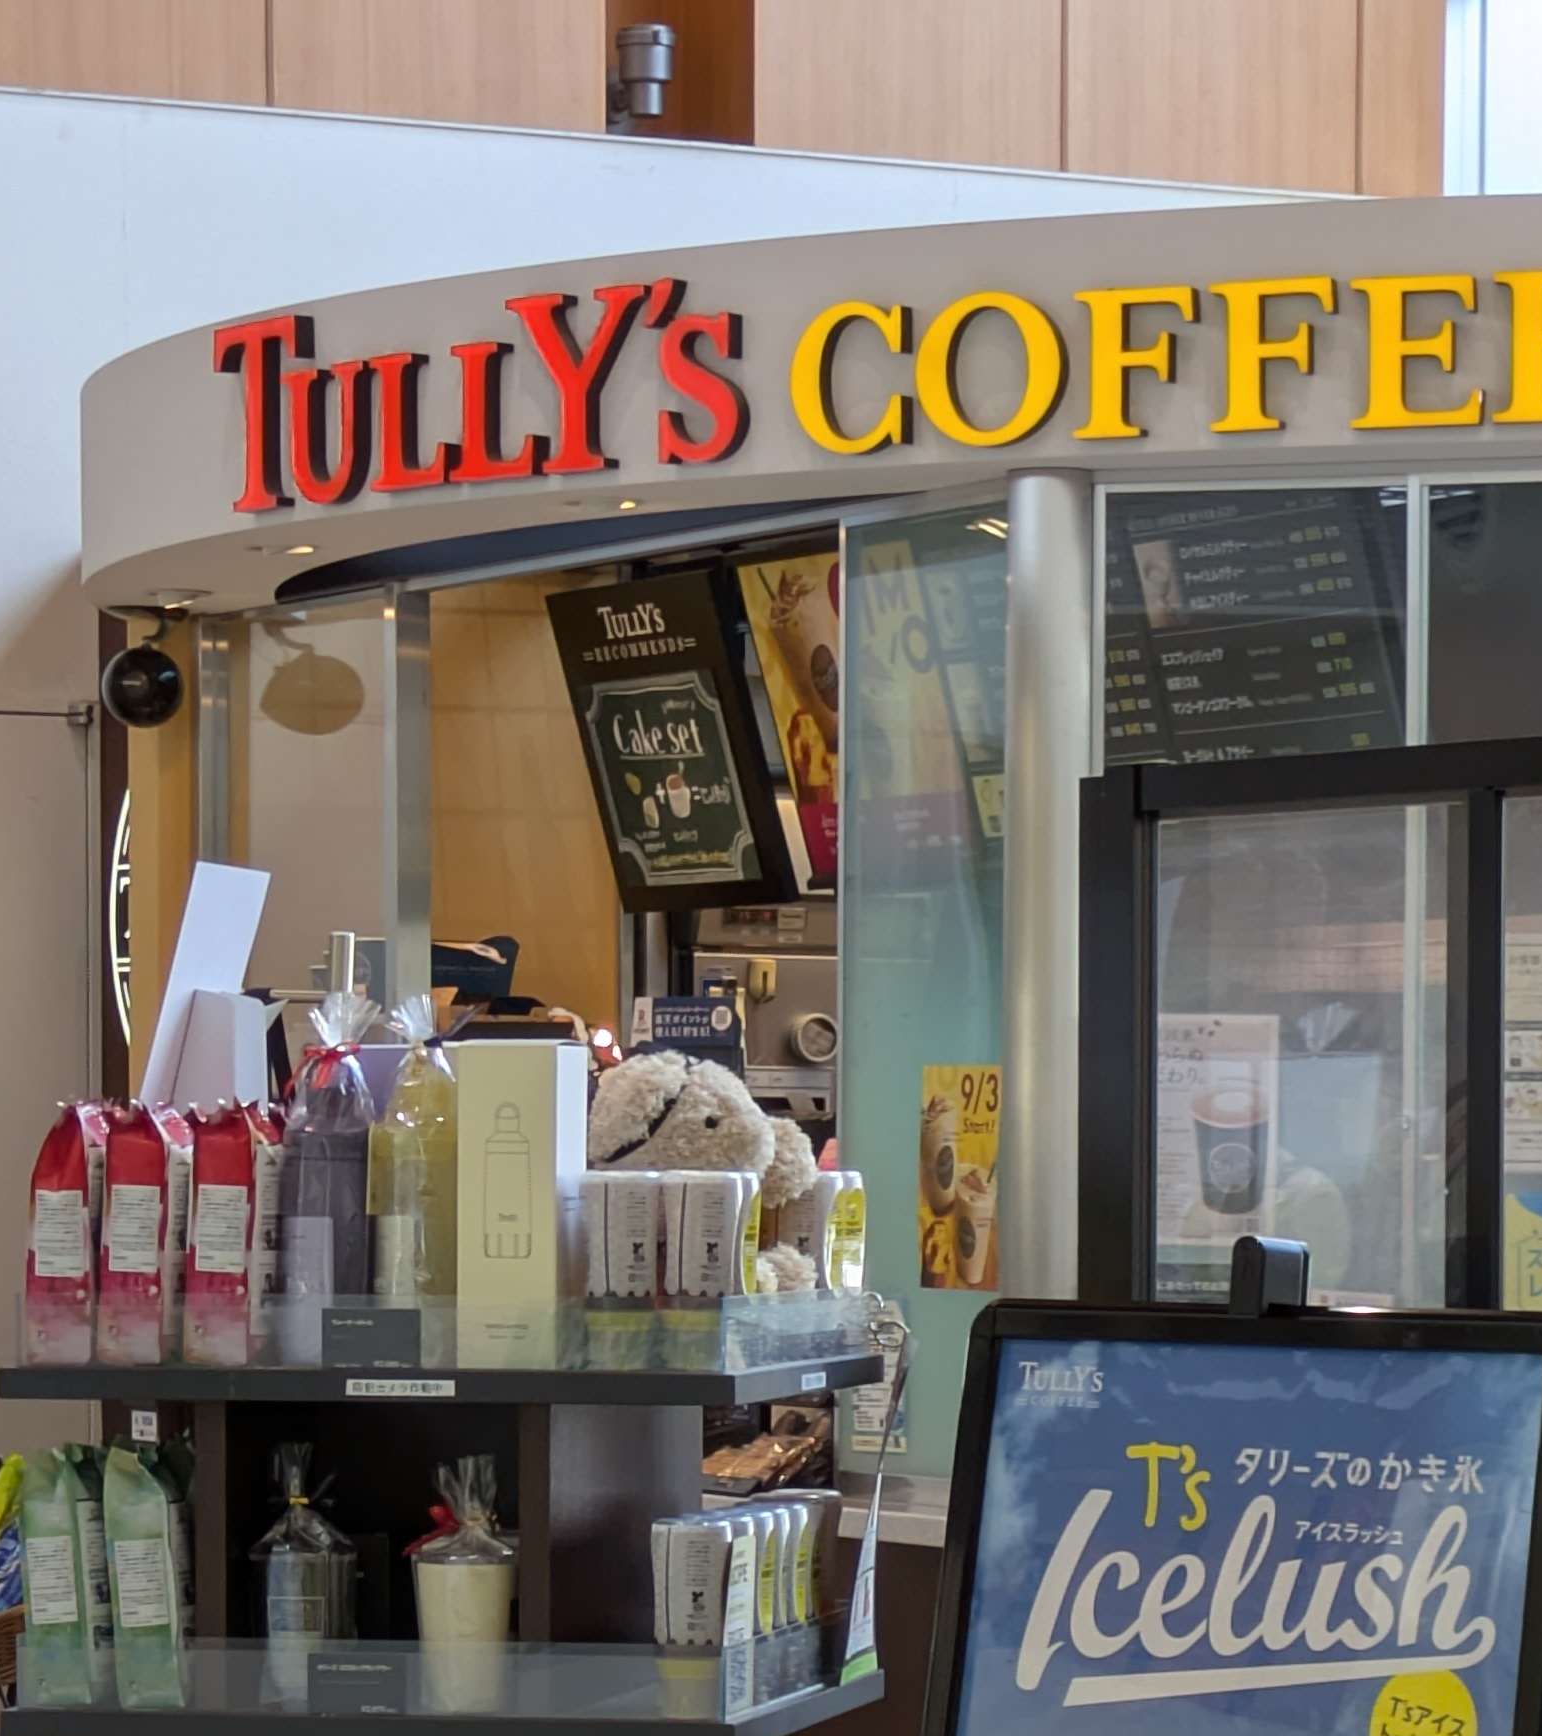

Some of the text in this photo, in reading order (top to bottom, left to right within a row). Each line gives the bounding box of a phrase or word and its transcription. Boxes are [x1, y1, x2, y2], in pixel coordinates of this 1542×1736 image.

[212, 276, 752, 512] TULLY'S
[597, 602, 666, 639] TULLY'S
[594, 637, 685, 662] RECOMMENDS
[613, 710, 703, 755] Cake set
[961, 1072, 999, 1114] 9/3
[1017, 1360, 1104, 1395] TULLY'S
[1126, 1442, 1211, 1532] T's
[1235, 1446, 1485, 1495] タリーズのかき氷
[1295, 1521, 1404, 1546] アイスラッシュ
[1015, 1489, 1497, 1691] Icelush
